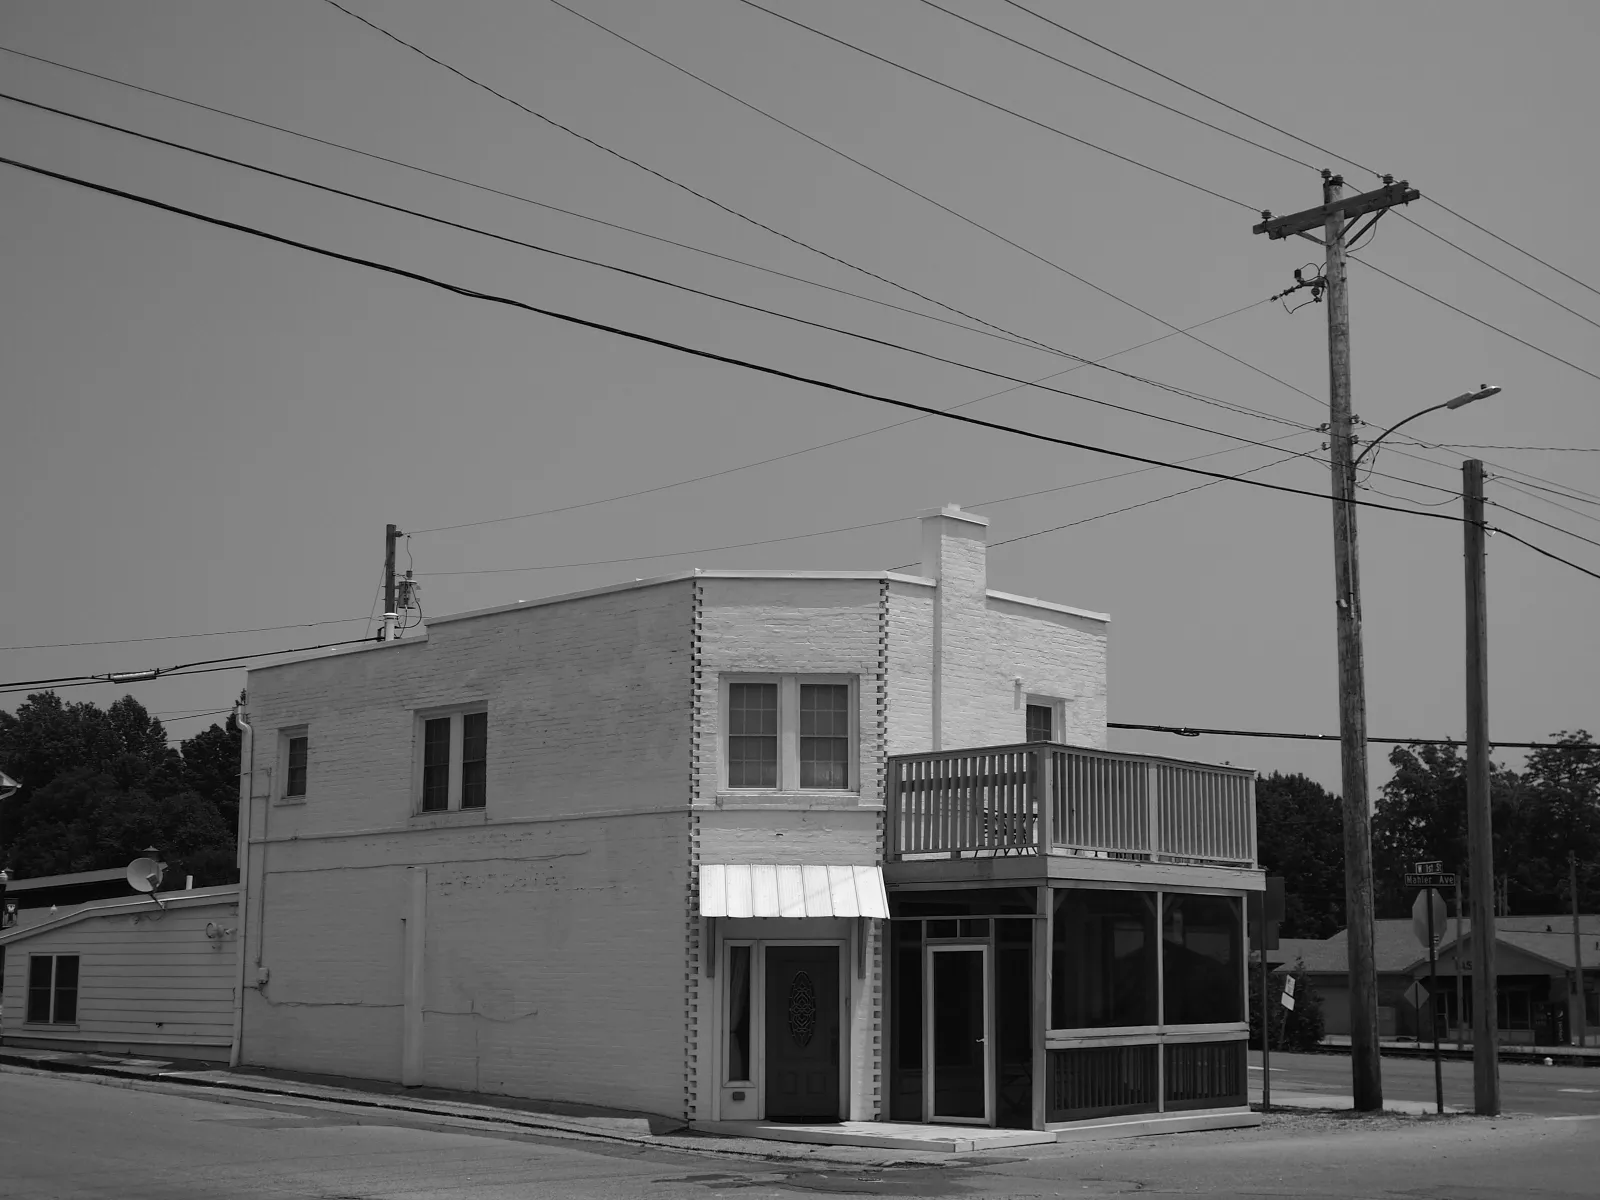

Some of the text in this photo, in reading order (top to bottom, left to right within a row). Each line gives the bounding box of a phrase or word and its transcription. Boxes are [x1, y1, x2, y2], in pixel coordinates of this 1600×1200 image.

[1426, 864, 1434, 873] 1st
[1436, 863, 1442, 872] St
[1406, 875, 1454, 884] Mahler Ave
